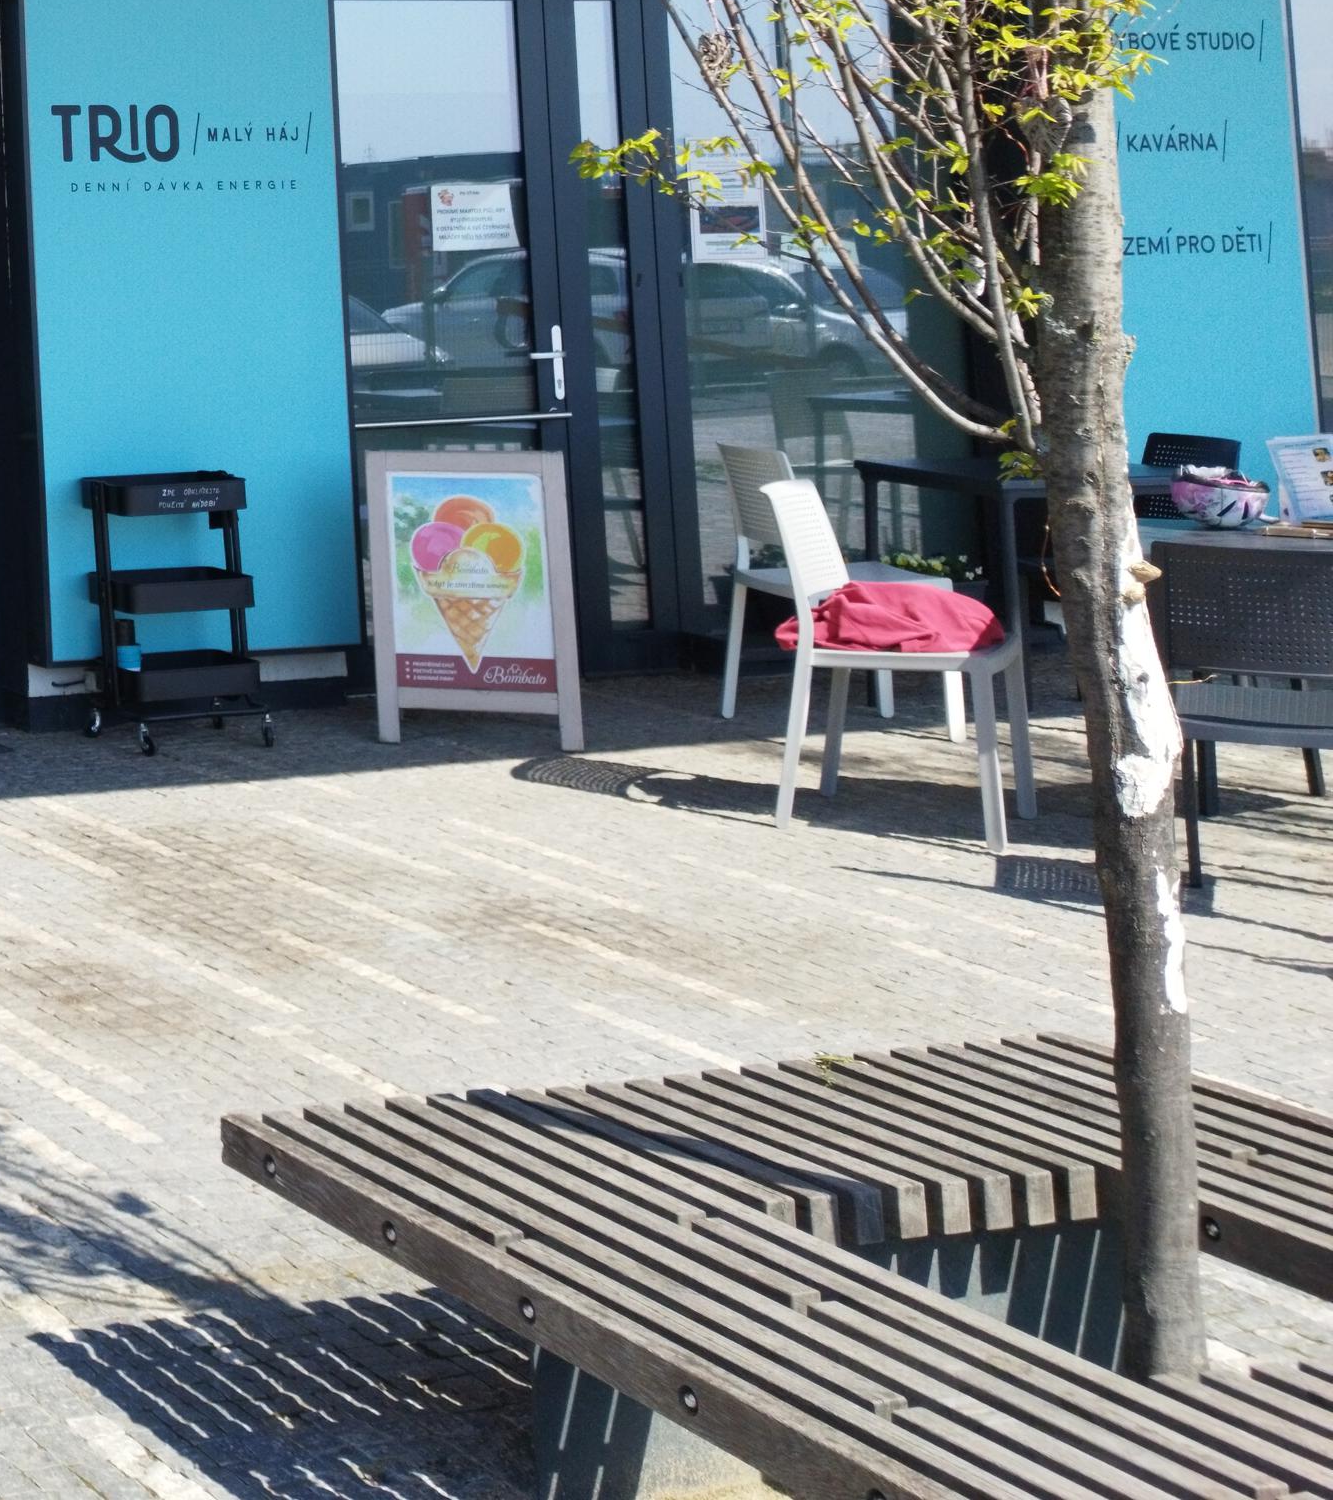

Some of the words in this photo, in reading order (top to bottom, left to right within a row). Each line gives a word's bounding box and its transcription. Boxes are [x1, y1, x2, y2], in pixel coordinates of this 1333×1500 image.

[1115, 23, 1180, 50] YBOVÉ
[1186, 31, 1255, 50] STUDIO
[51, 104, 180, 164] TRIO
[1126, 124, 1218, 152] KAVÁRNA
[71, 178, 131, 193] DENNÍ
[144, 177, 204, 192] DÁVKA
[217, 179, 298, 191] ENERGIE
[1122, 227, 1171, 256] ZEMÍ
[1176, 235, 1215, 254] PRO
[1222, 226, 1263, 252] DĚTI
[483, 664, 547, 685] Bombato
